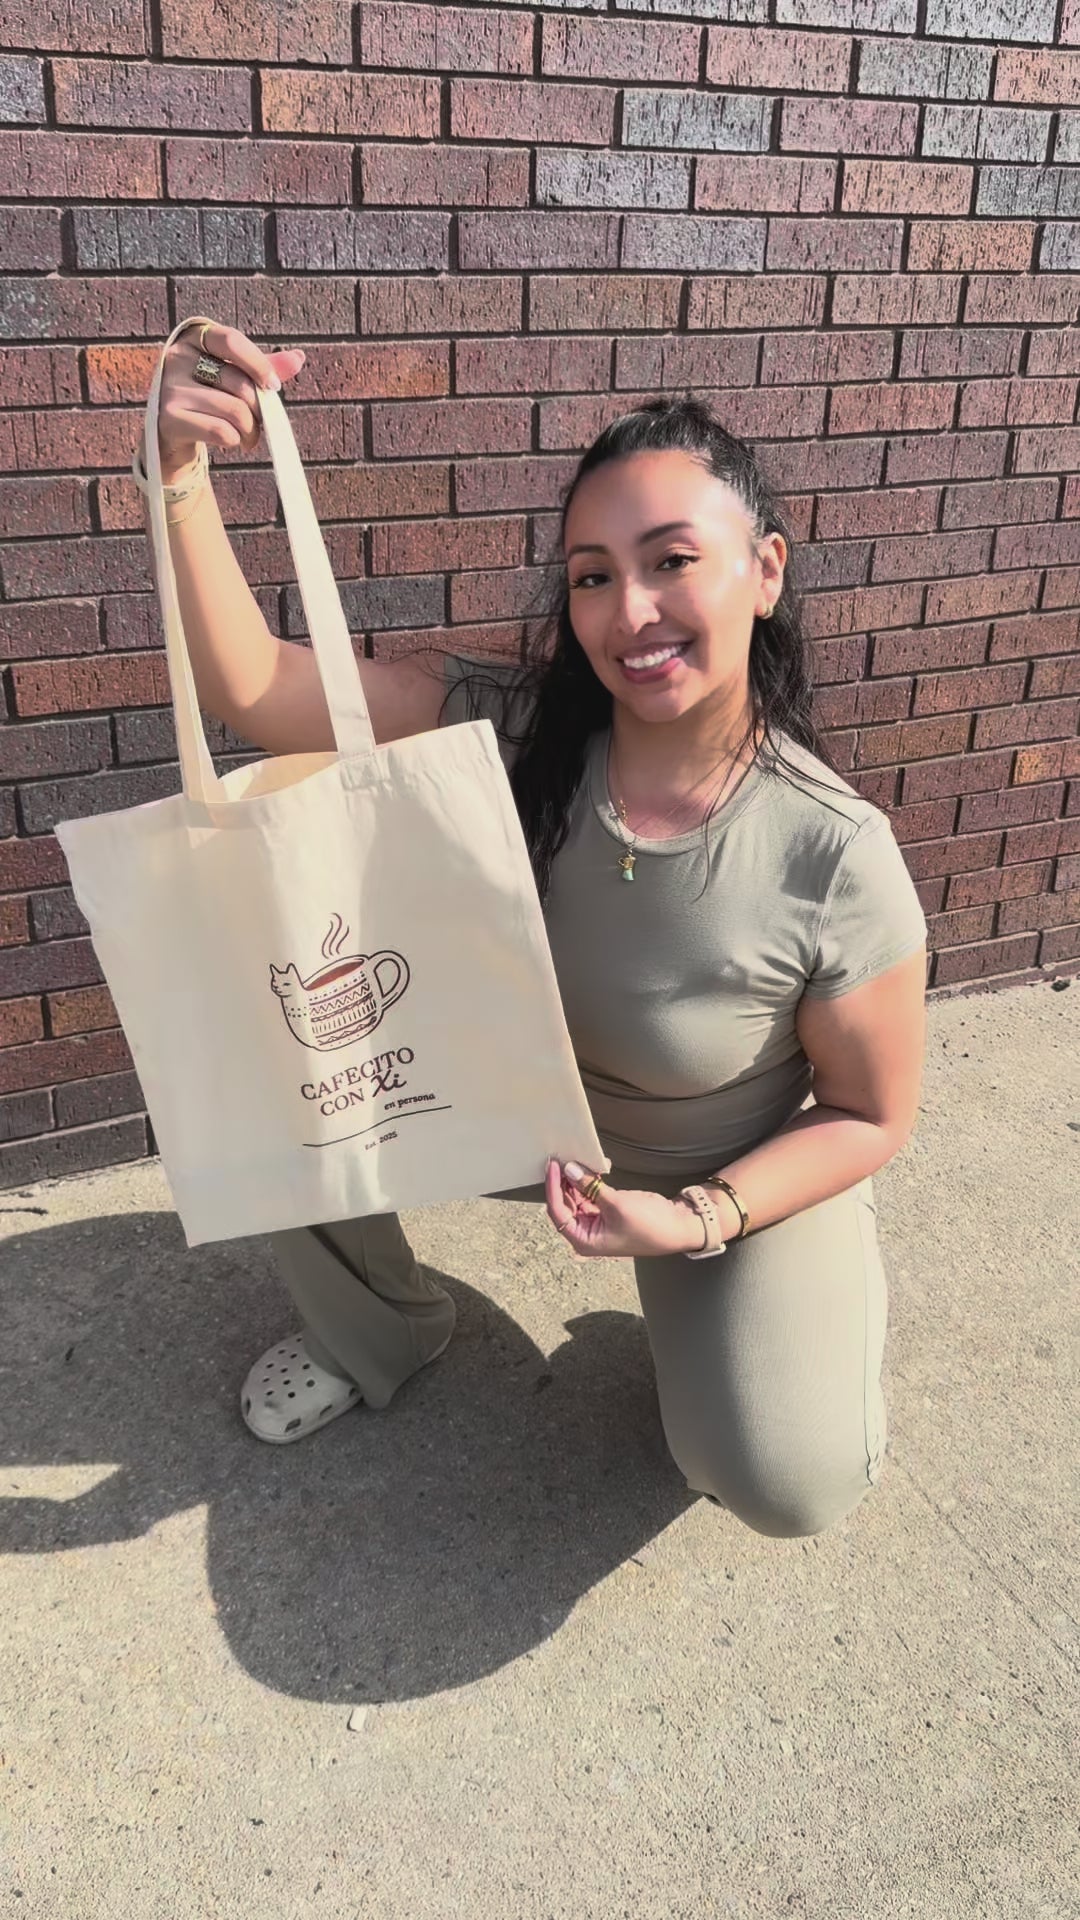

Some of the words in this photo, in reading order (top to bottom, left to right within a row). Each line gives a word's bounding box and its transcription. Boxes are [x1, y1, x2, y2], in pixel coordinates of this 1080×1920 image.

[301, 1047, 415, 1101] CAFECITO
[320, 1088, 365, 1116] CON
[371, 1069, 408, 1098] Xi
[384, 1100, 396, 1110] en
[397, 1092, 436, 1108] persona
[379, 1131, 398, 1144] 2025
